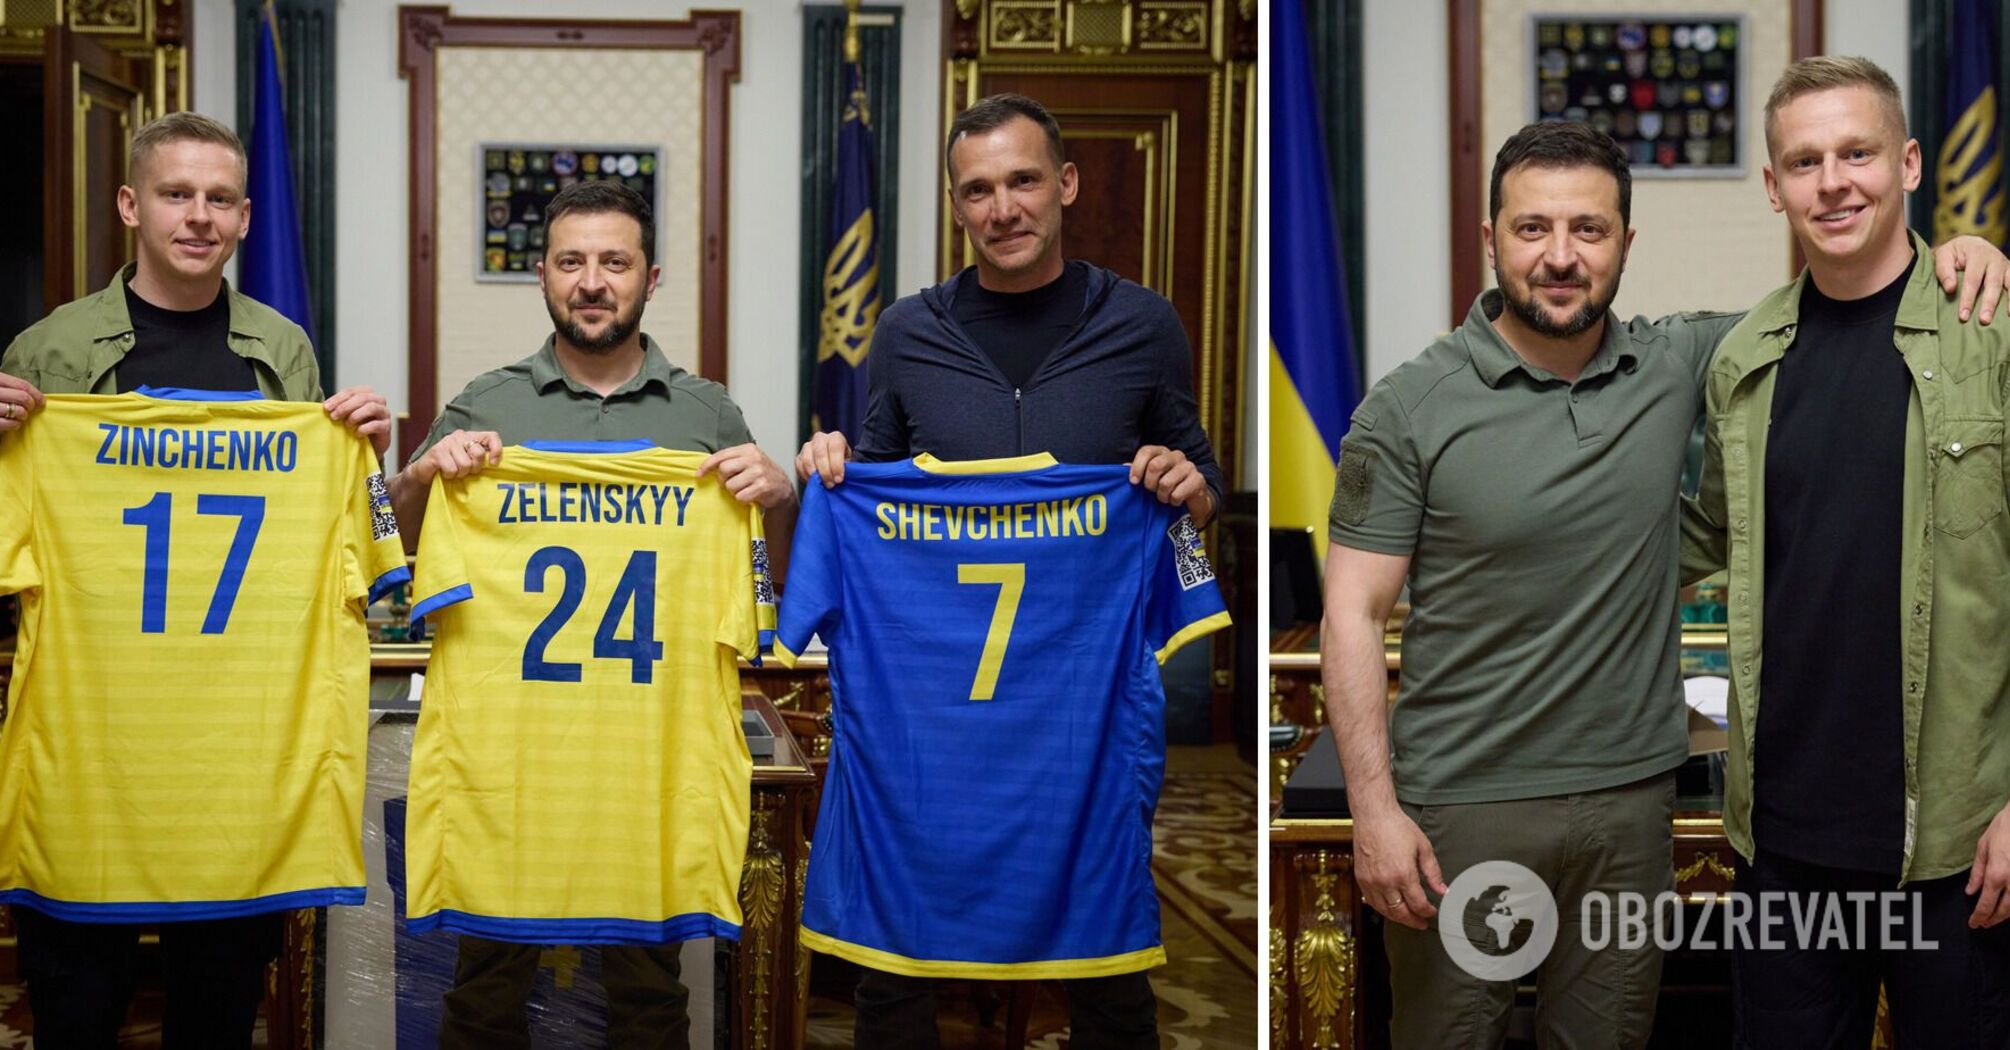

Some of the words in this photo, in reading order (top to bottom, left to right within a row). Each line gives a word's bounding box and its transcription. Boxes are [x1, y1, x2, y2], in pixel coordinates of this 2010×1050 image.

[96, 423, 297, 472] ZINCHENKO
[497, 482, 694, 526] ZELENSKYY
[877, 494, 1107, 540] SHEVCHENKO
[122, 492, 266, 635] 17
[522, 546, 663, 684] 24
[957, 562, 1025, 701] 7
